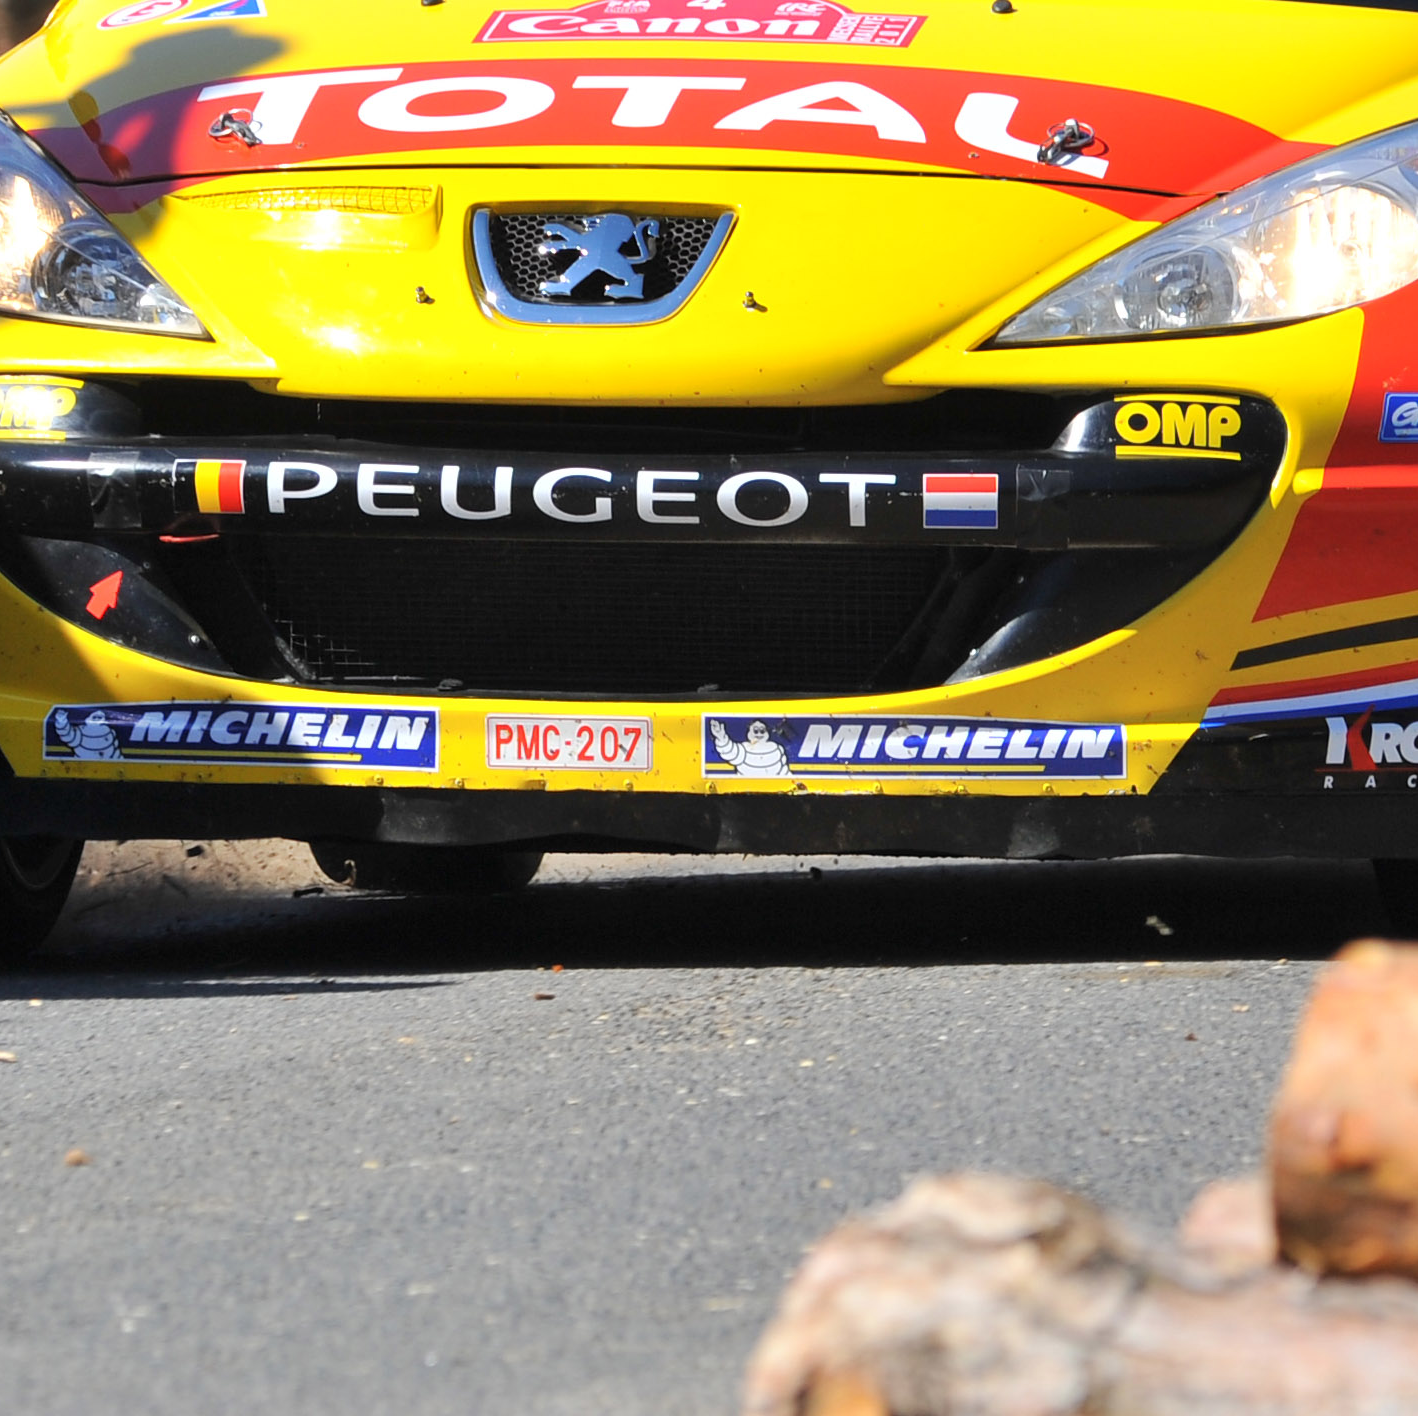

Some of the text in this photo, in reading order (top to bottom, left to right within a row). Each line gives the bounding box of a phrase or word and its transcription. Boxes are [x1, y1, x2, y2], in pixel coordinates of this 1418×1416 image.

[508, 13, 819, 36] Canon
[198, 68, 1109, 178] TOTAL
[1114, 402, 1241, 449] OMP
[267, 461, 896, 526] PEUGEOT
[130, 710, 430, 751] MICHELIN
[495, 724, 642, 762] PMC-207
[797, 723, 1116, 760] MICHELIN
